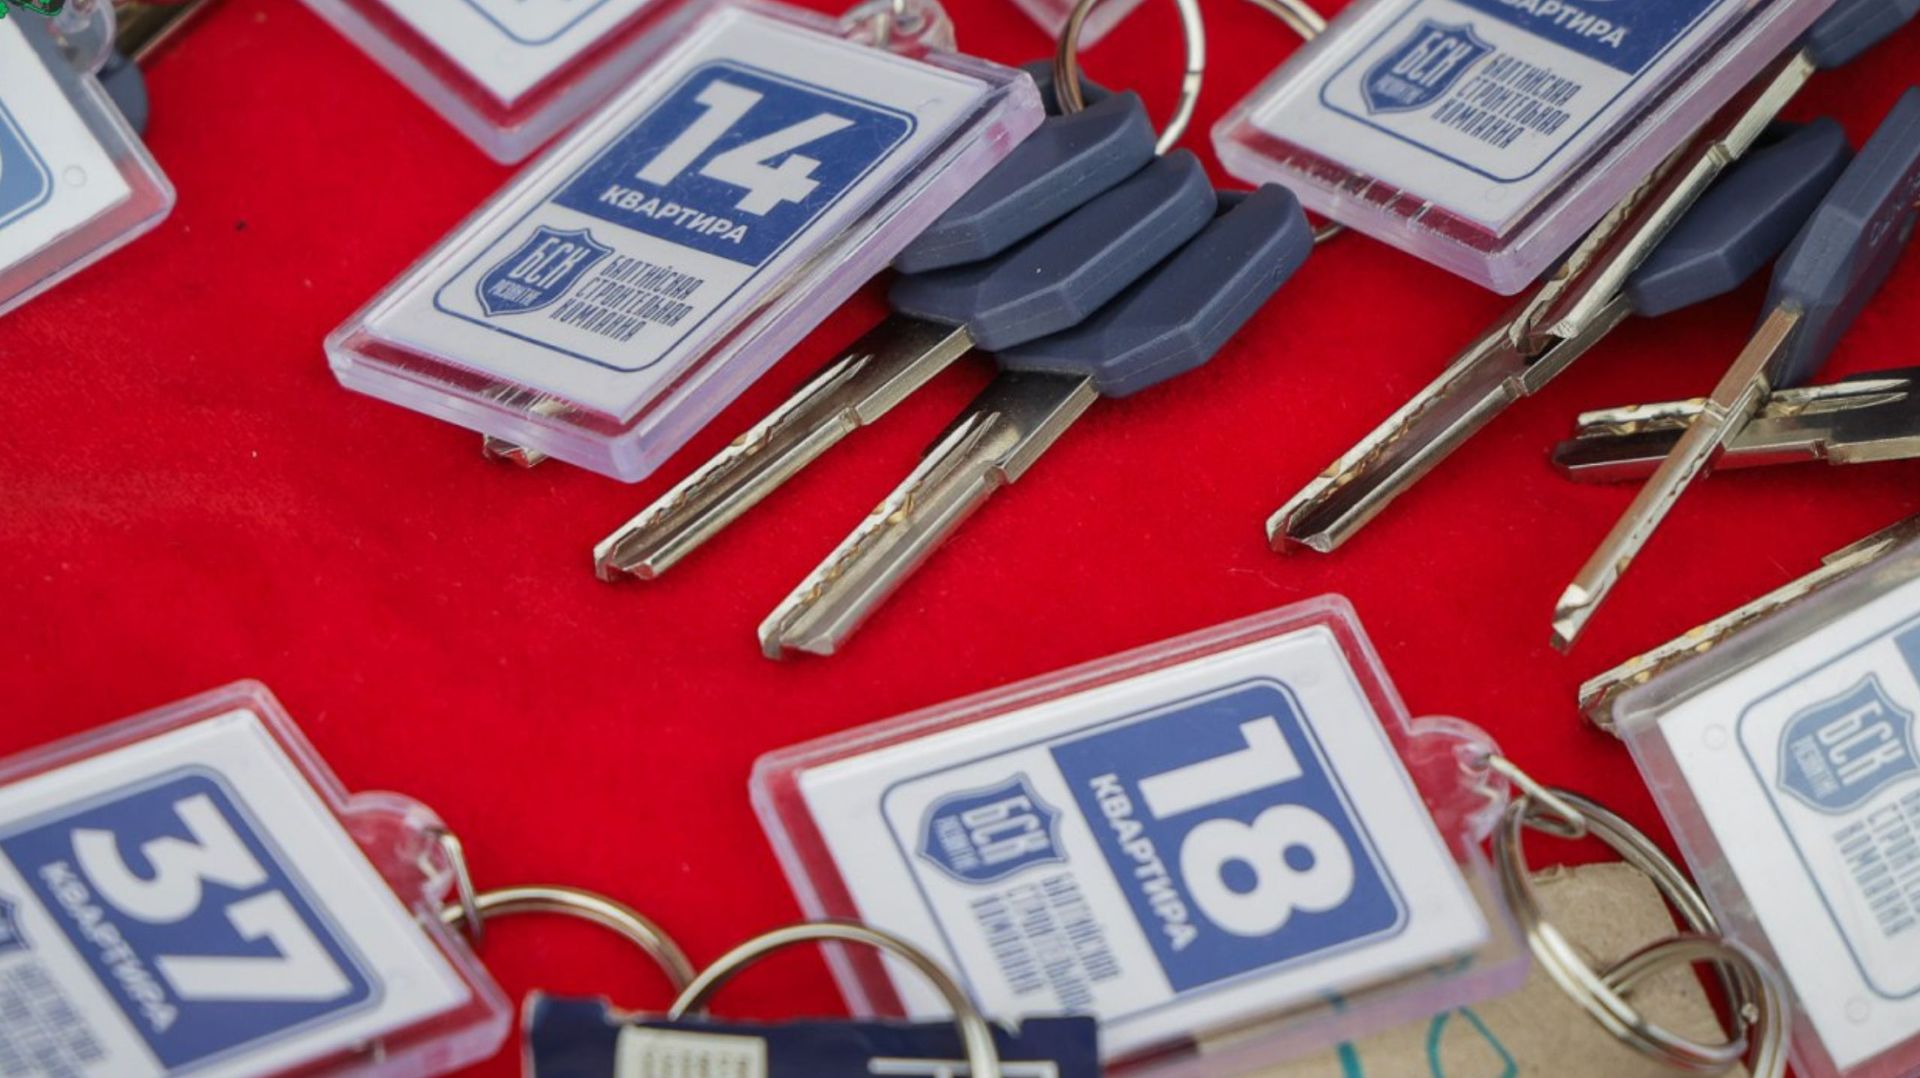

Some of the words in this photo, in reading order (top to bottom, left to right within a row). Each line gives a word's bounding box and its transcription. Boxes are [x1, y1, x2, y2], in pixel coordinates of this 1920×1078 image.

[1392, 31, 1473, 87] БСК
[1481, 53, 1582, 106] БАЛТИЙСКАЯ
[1431, 98, 1525, 148] КОМПАНИЯ
[1457, 76, 1570, 135] СТРОИТЕЛЬНАЯ
[635, 79, 857, 216] 14
[600, 184, 749, 244] КВАРТИРА
[507, 236, 591, 289] БСК
[600, 254, 704, 300] БАЛТИЙСКАЯ
[549, 298, 647, 342] КОМПАНИЯ
[575, 276, 694, 327] СТРОИТЕЛЬНАЯ
[1817, 700, 1904, 787] БСК
[961, 794, 1050, 865] БСК
[1137, 715, 1356, 937] 18
[1089, 773, 1198, 951] КВАРТИРА
[71, 793, 353, 1002] 37
